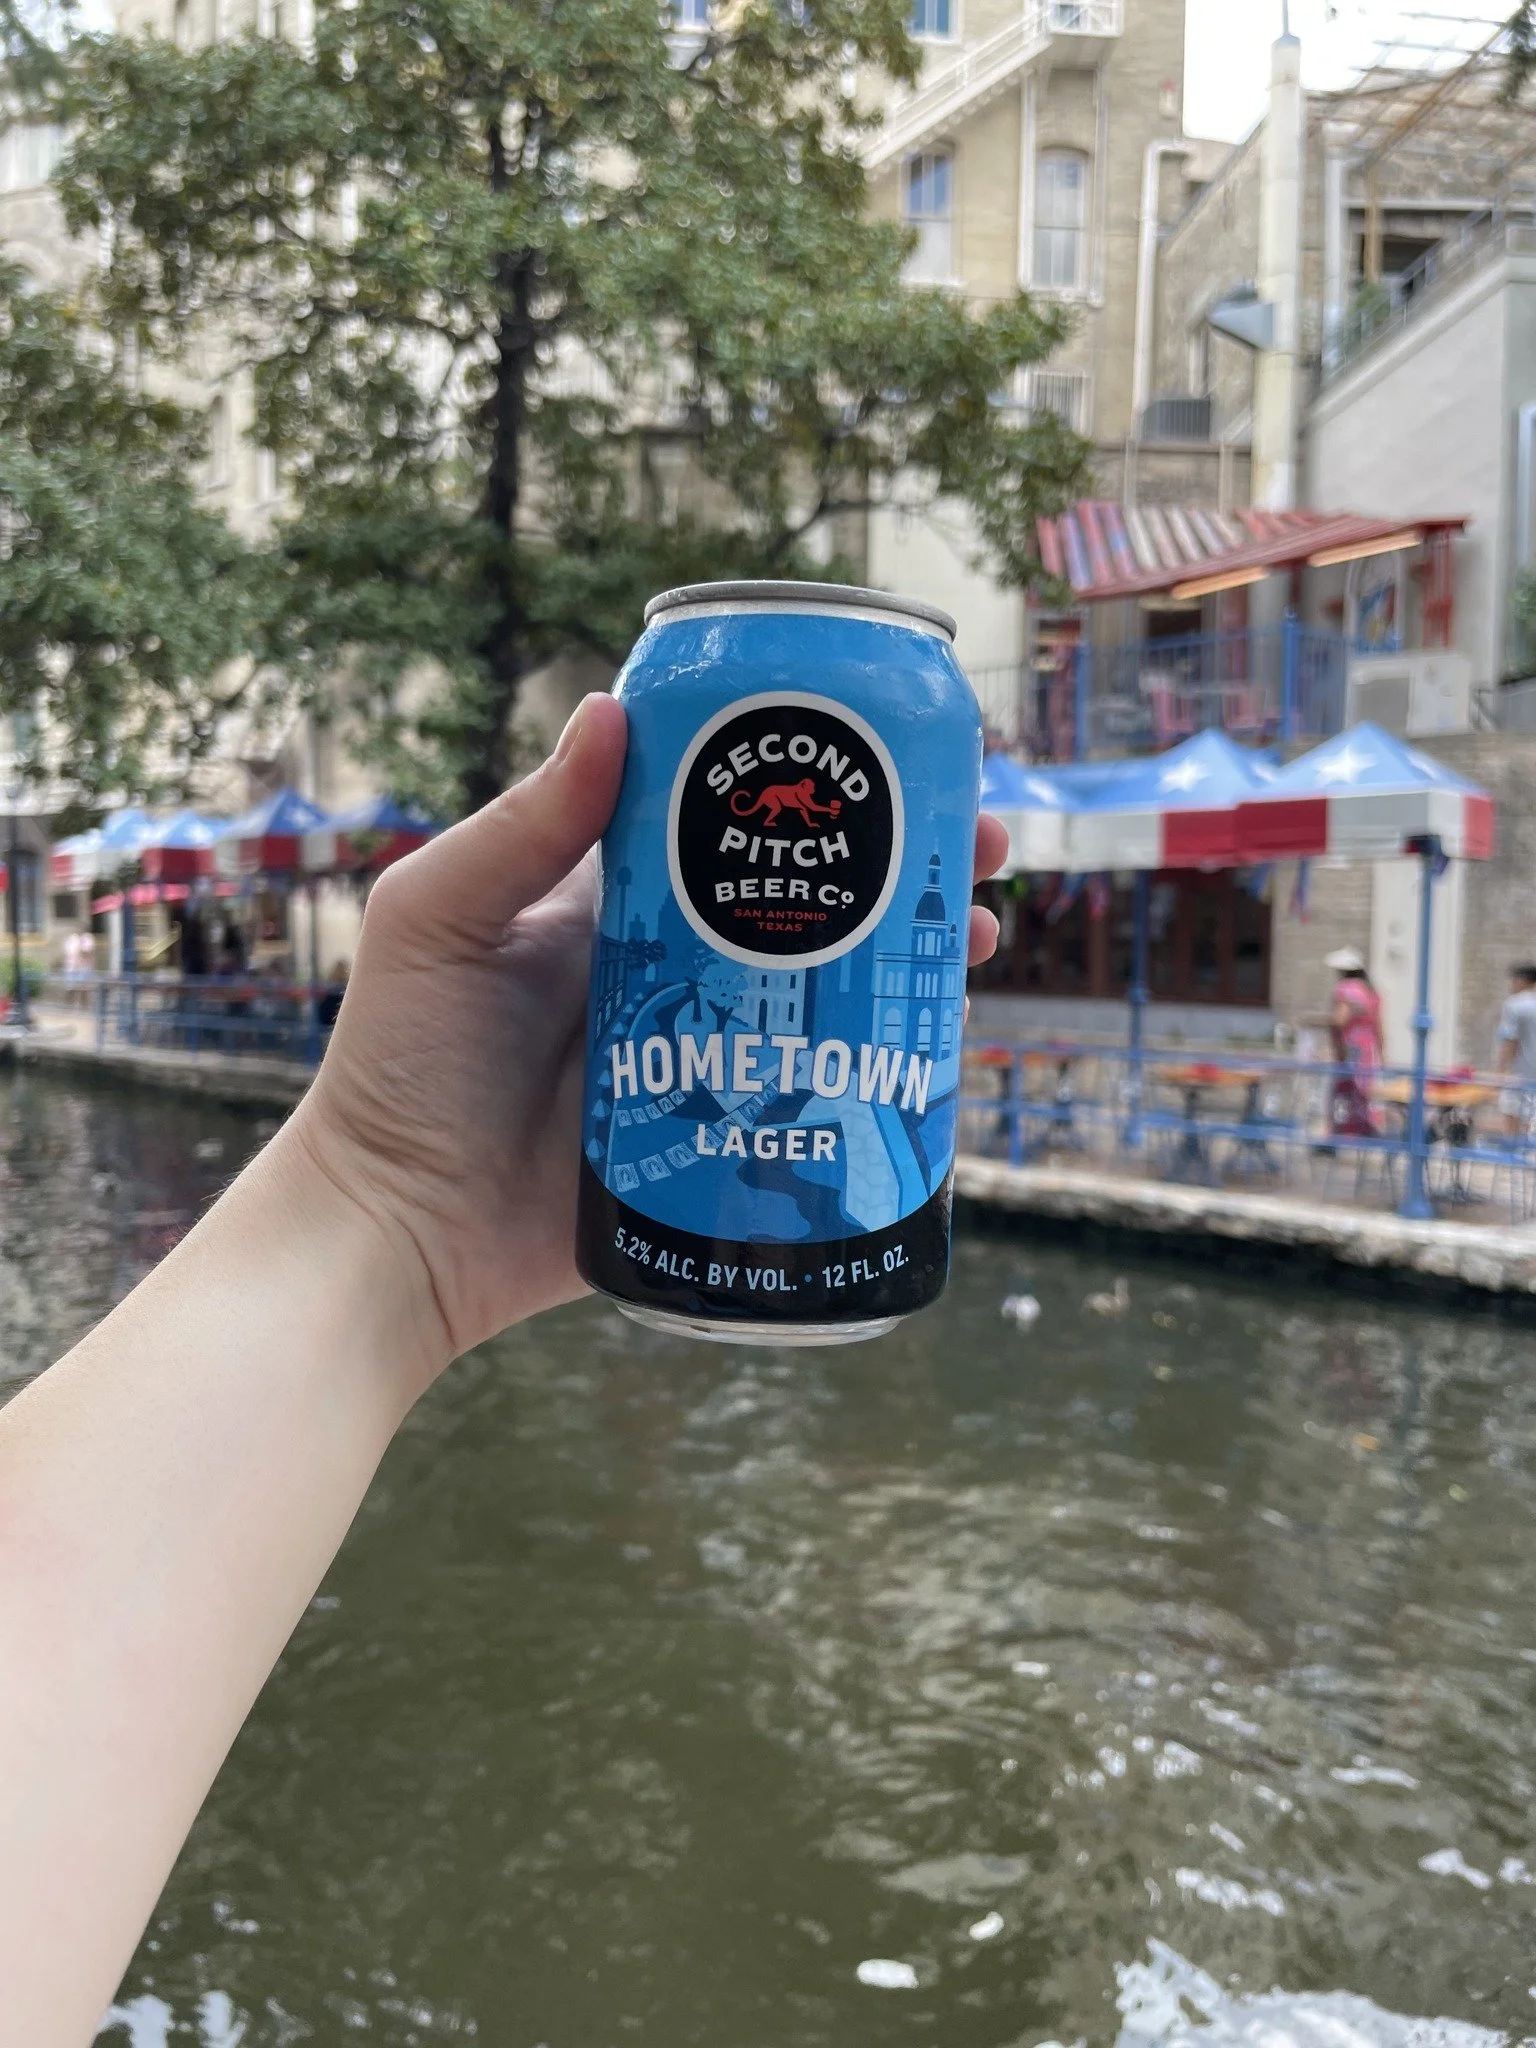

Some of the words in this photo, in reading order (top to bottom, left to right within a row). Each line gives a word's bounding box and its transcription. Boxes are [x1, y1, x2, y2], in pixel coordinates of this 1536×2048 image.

[707, 733, 869, 802] SECOND
[718, 825, 850, 867] PITCH
[714, 877, 810, 903] BEER
[733, 908, 762, 918] SAN
[766, 909, 828, 921] ANTONIO
[757, 921, 803, 932] TEXAS
[611, 1033, 933, 1115] HOMETOWN
[695, 1123, 837, 1162] LAGER
[615, 1227, 652, 1265] 5.2%
[654, 1250, 699, 1282] ALC.
[707, 1262, 739, 1290] BY
[745, 1268, 797, 1291] VOL.
[822, 1264, 845, 1289] 12
[851, 1260, 879, 1284] FL.
[883, 1244, 909, 1272] OZ.
